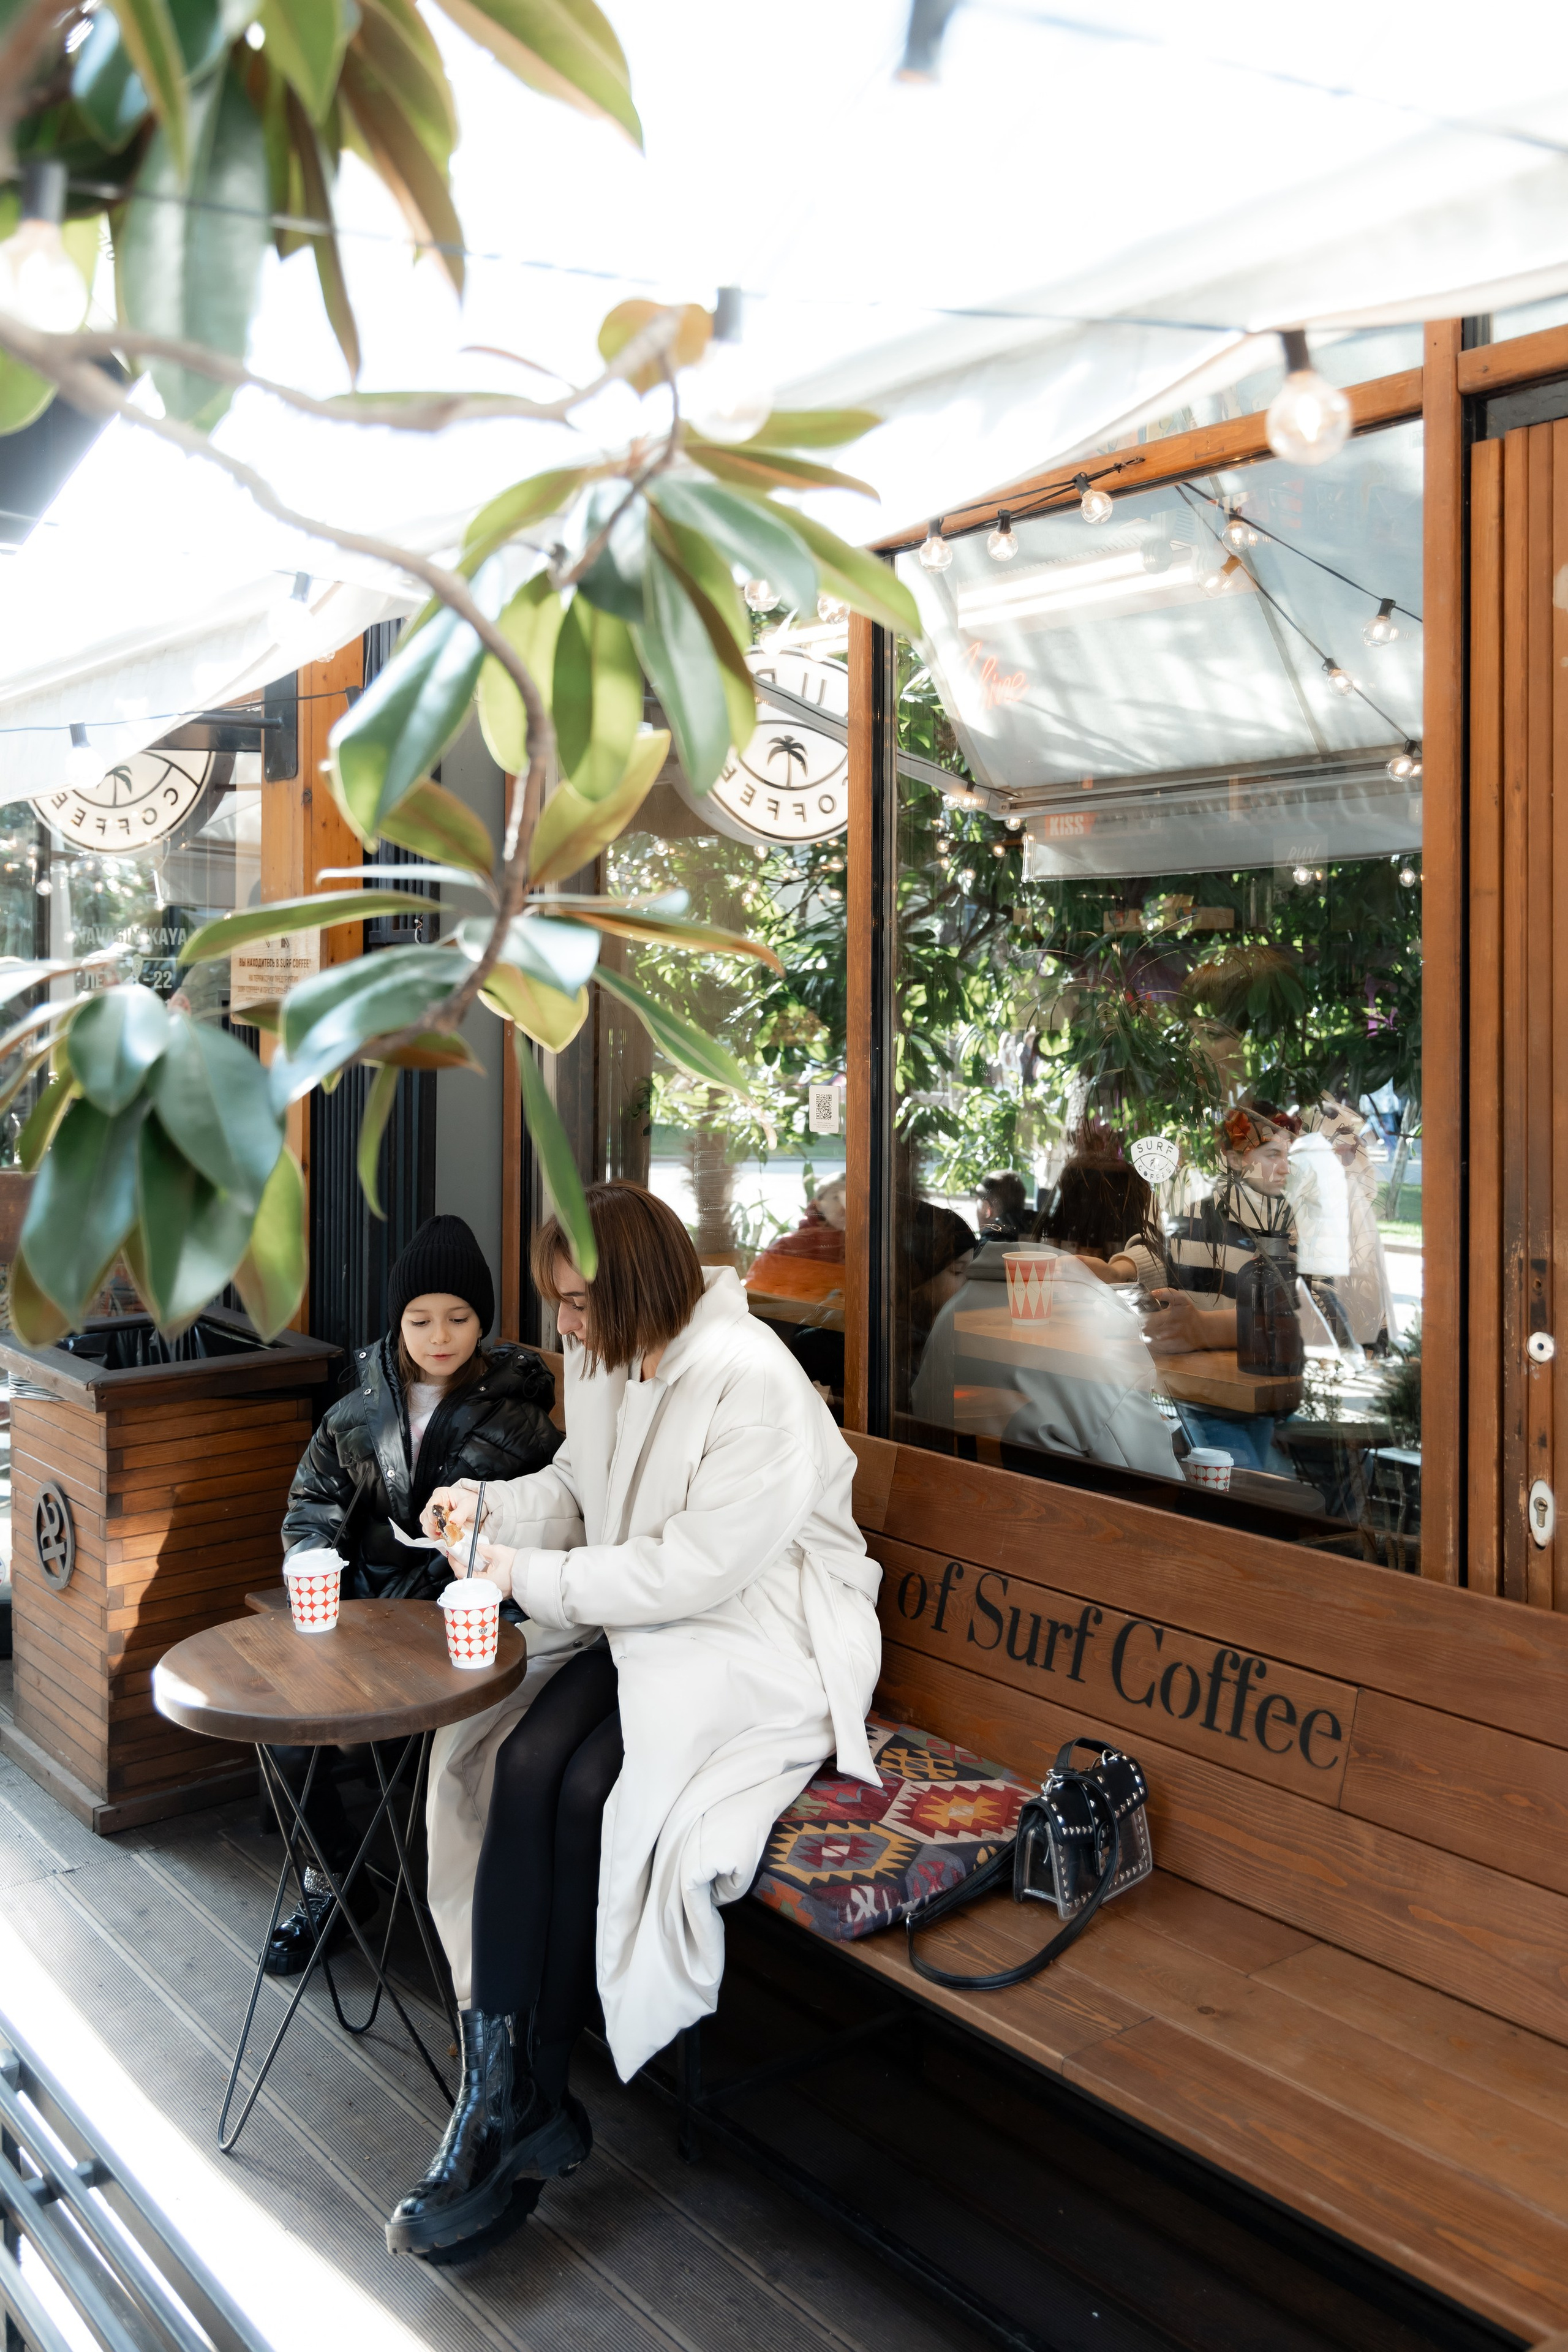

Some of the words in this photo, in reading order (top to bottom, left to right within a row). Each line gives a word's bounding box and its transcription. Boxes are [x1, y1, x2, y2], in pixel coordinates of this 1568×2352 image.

[1050, 815, 1084, 836] KISS
[280, 959, 292, 968] SURF
[153, 970, 173, 989] 22
[1136, 1140, 1174, 1154] SURF
[898, 1562, 964, 1634] of
[968, 1572, 1103, 1683] Surf
[1112, 1620, 1343, 1770] Coffee
